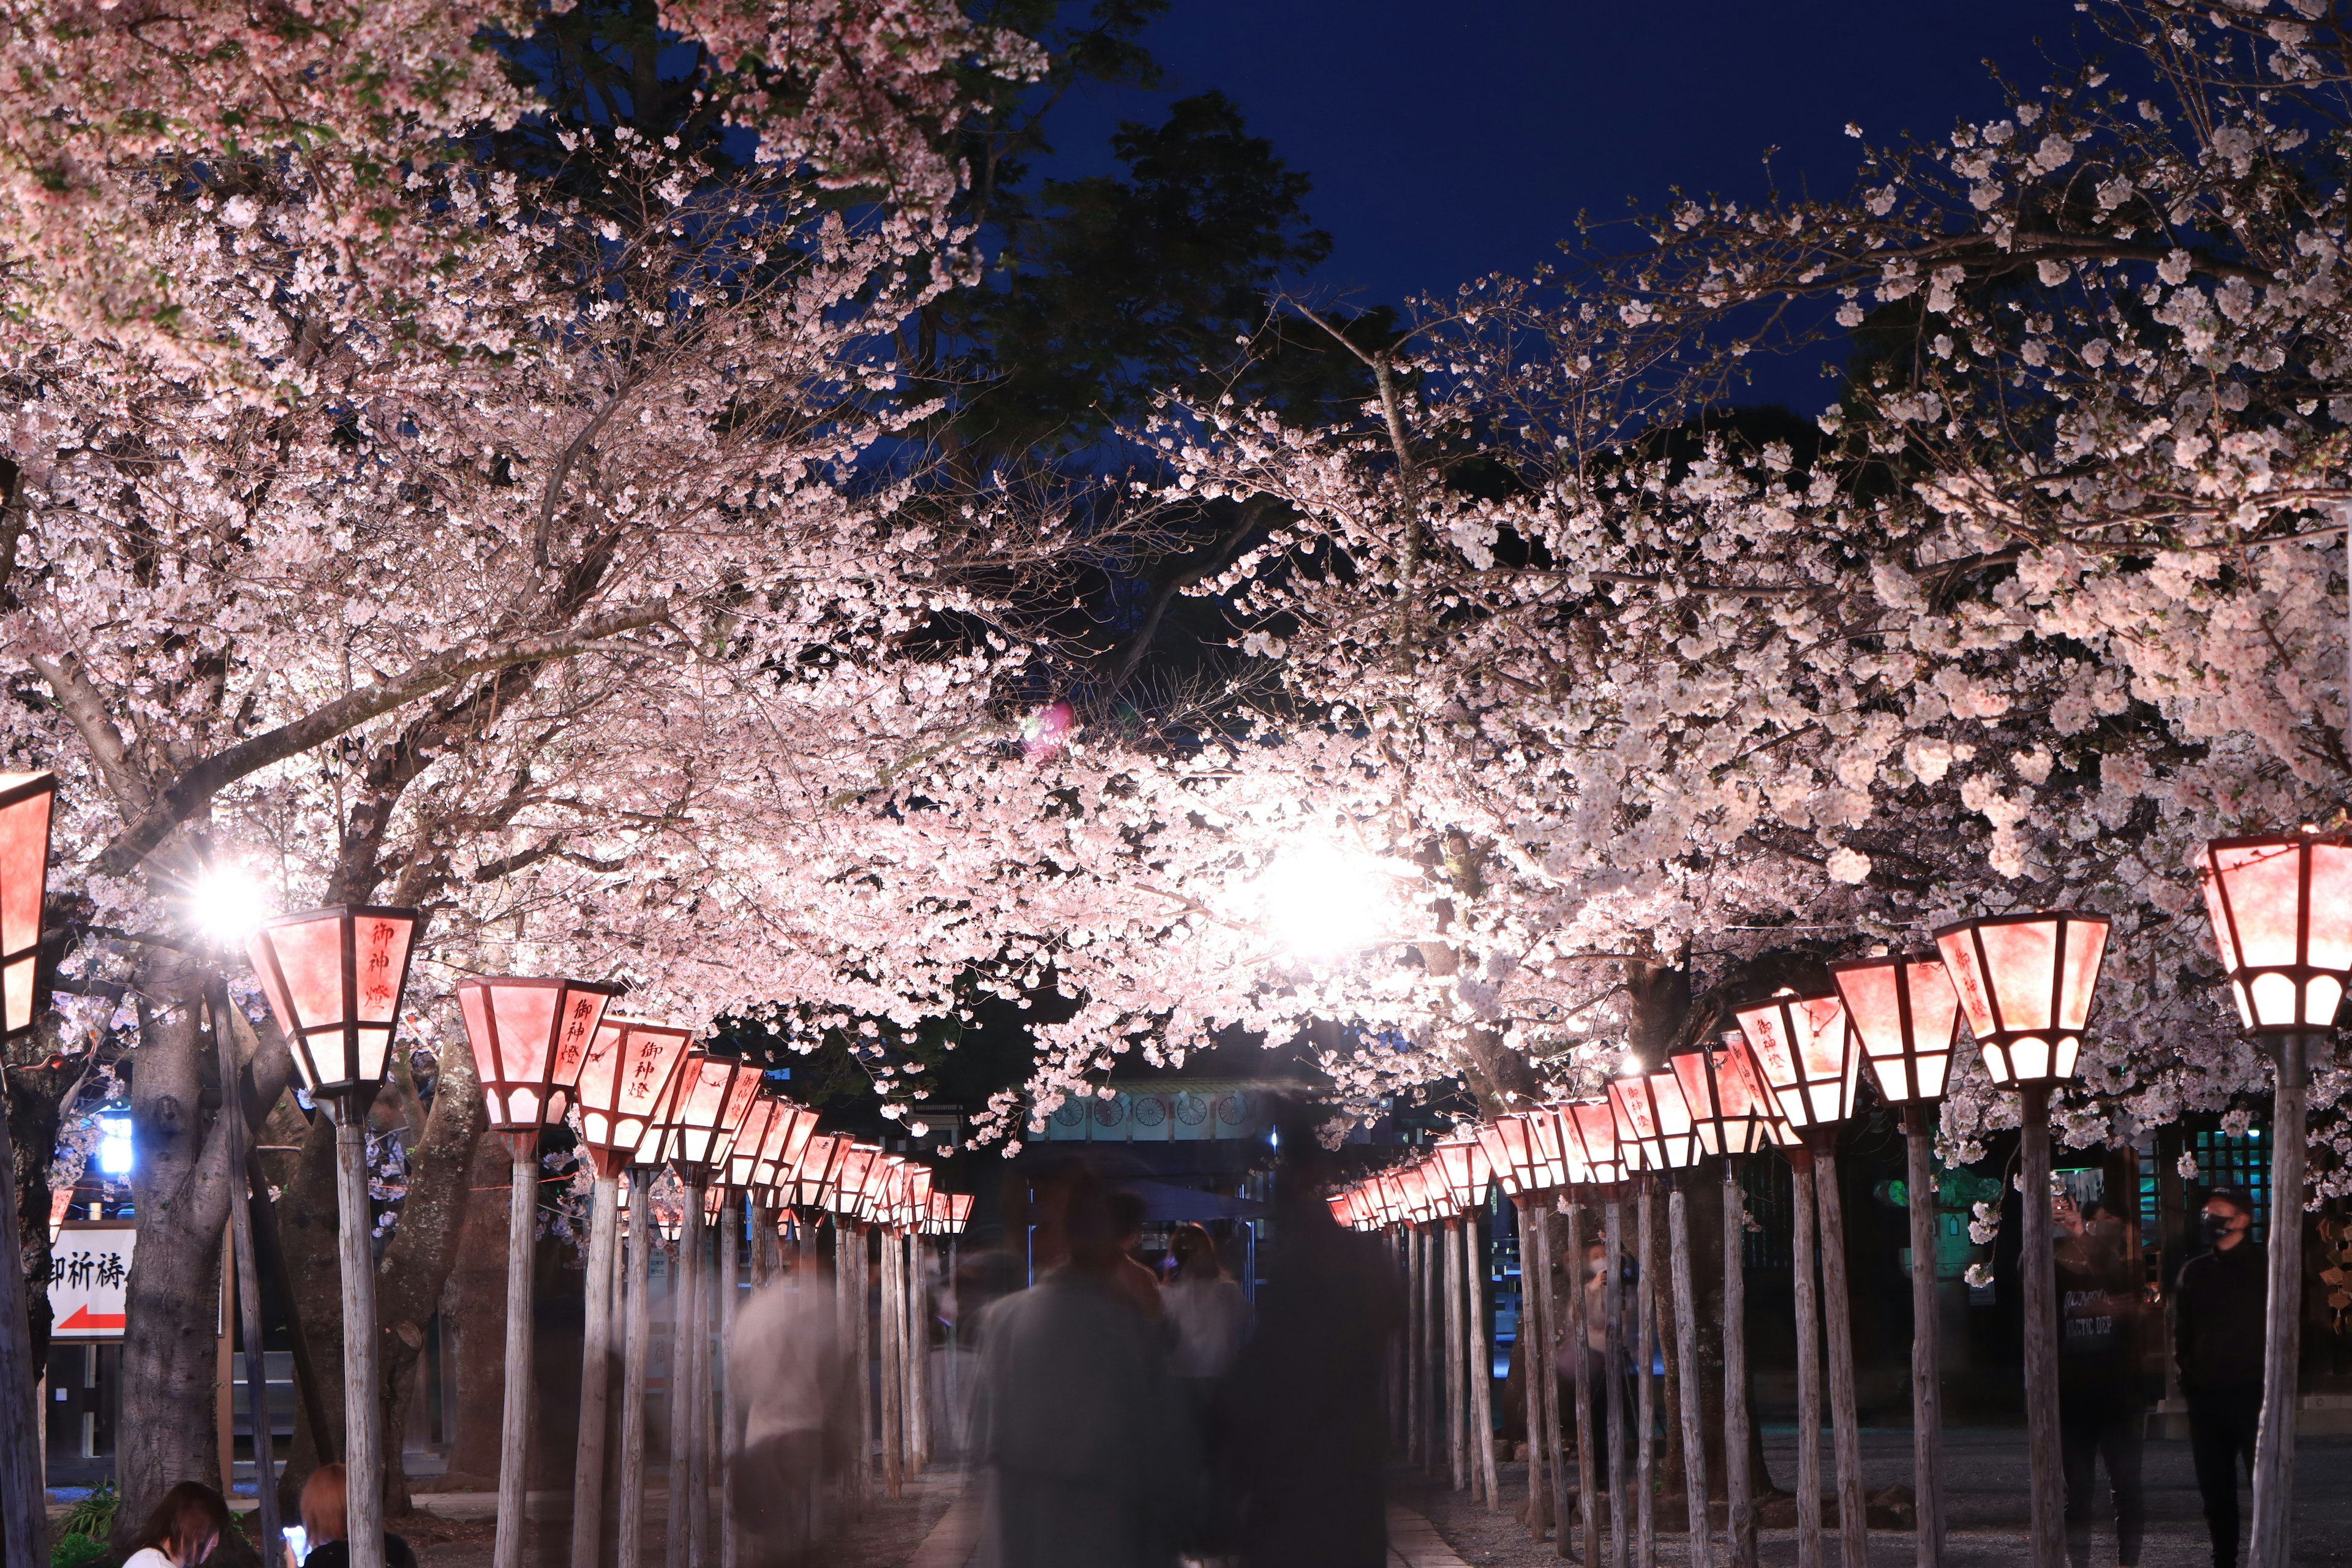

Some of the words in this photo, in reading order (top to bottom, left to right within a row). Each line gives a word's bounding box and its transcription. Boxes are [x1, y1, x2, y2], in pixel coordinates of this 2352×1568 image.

[364, 922, 394, 1009] 御神燈
[1955, 948, 1986, 1017] 御神燈
[560, 999, 592, 1065] 御神燈
[1757, 1019, 1785, 1069] 御神燈
[627, 1041, 663, 1099] 御神燈
